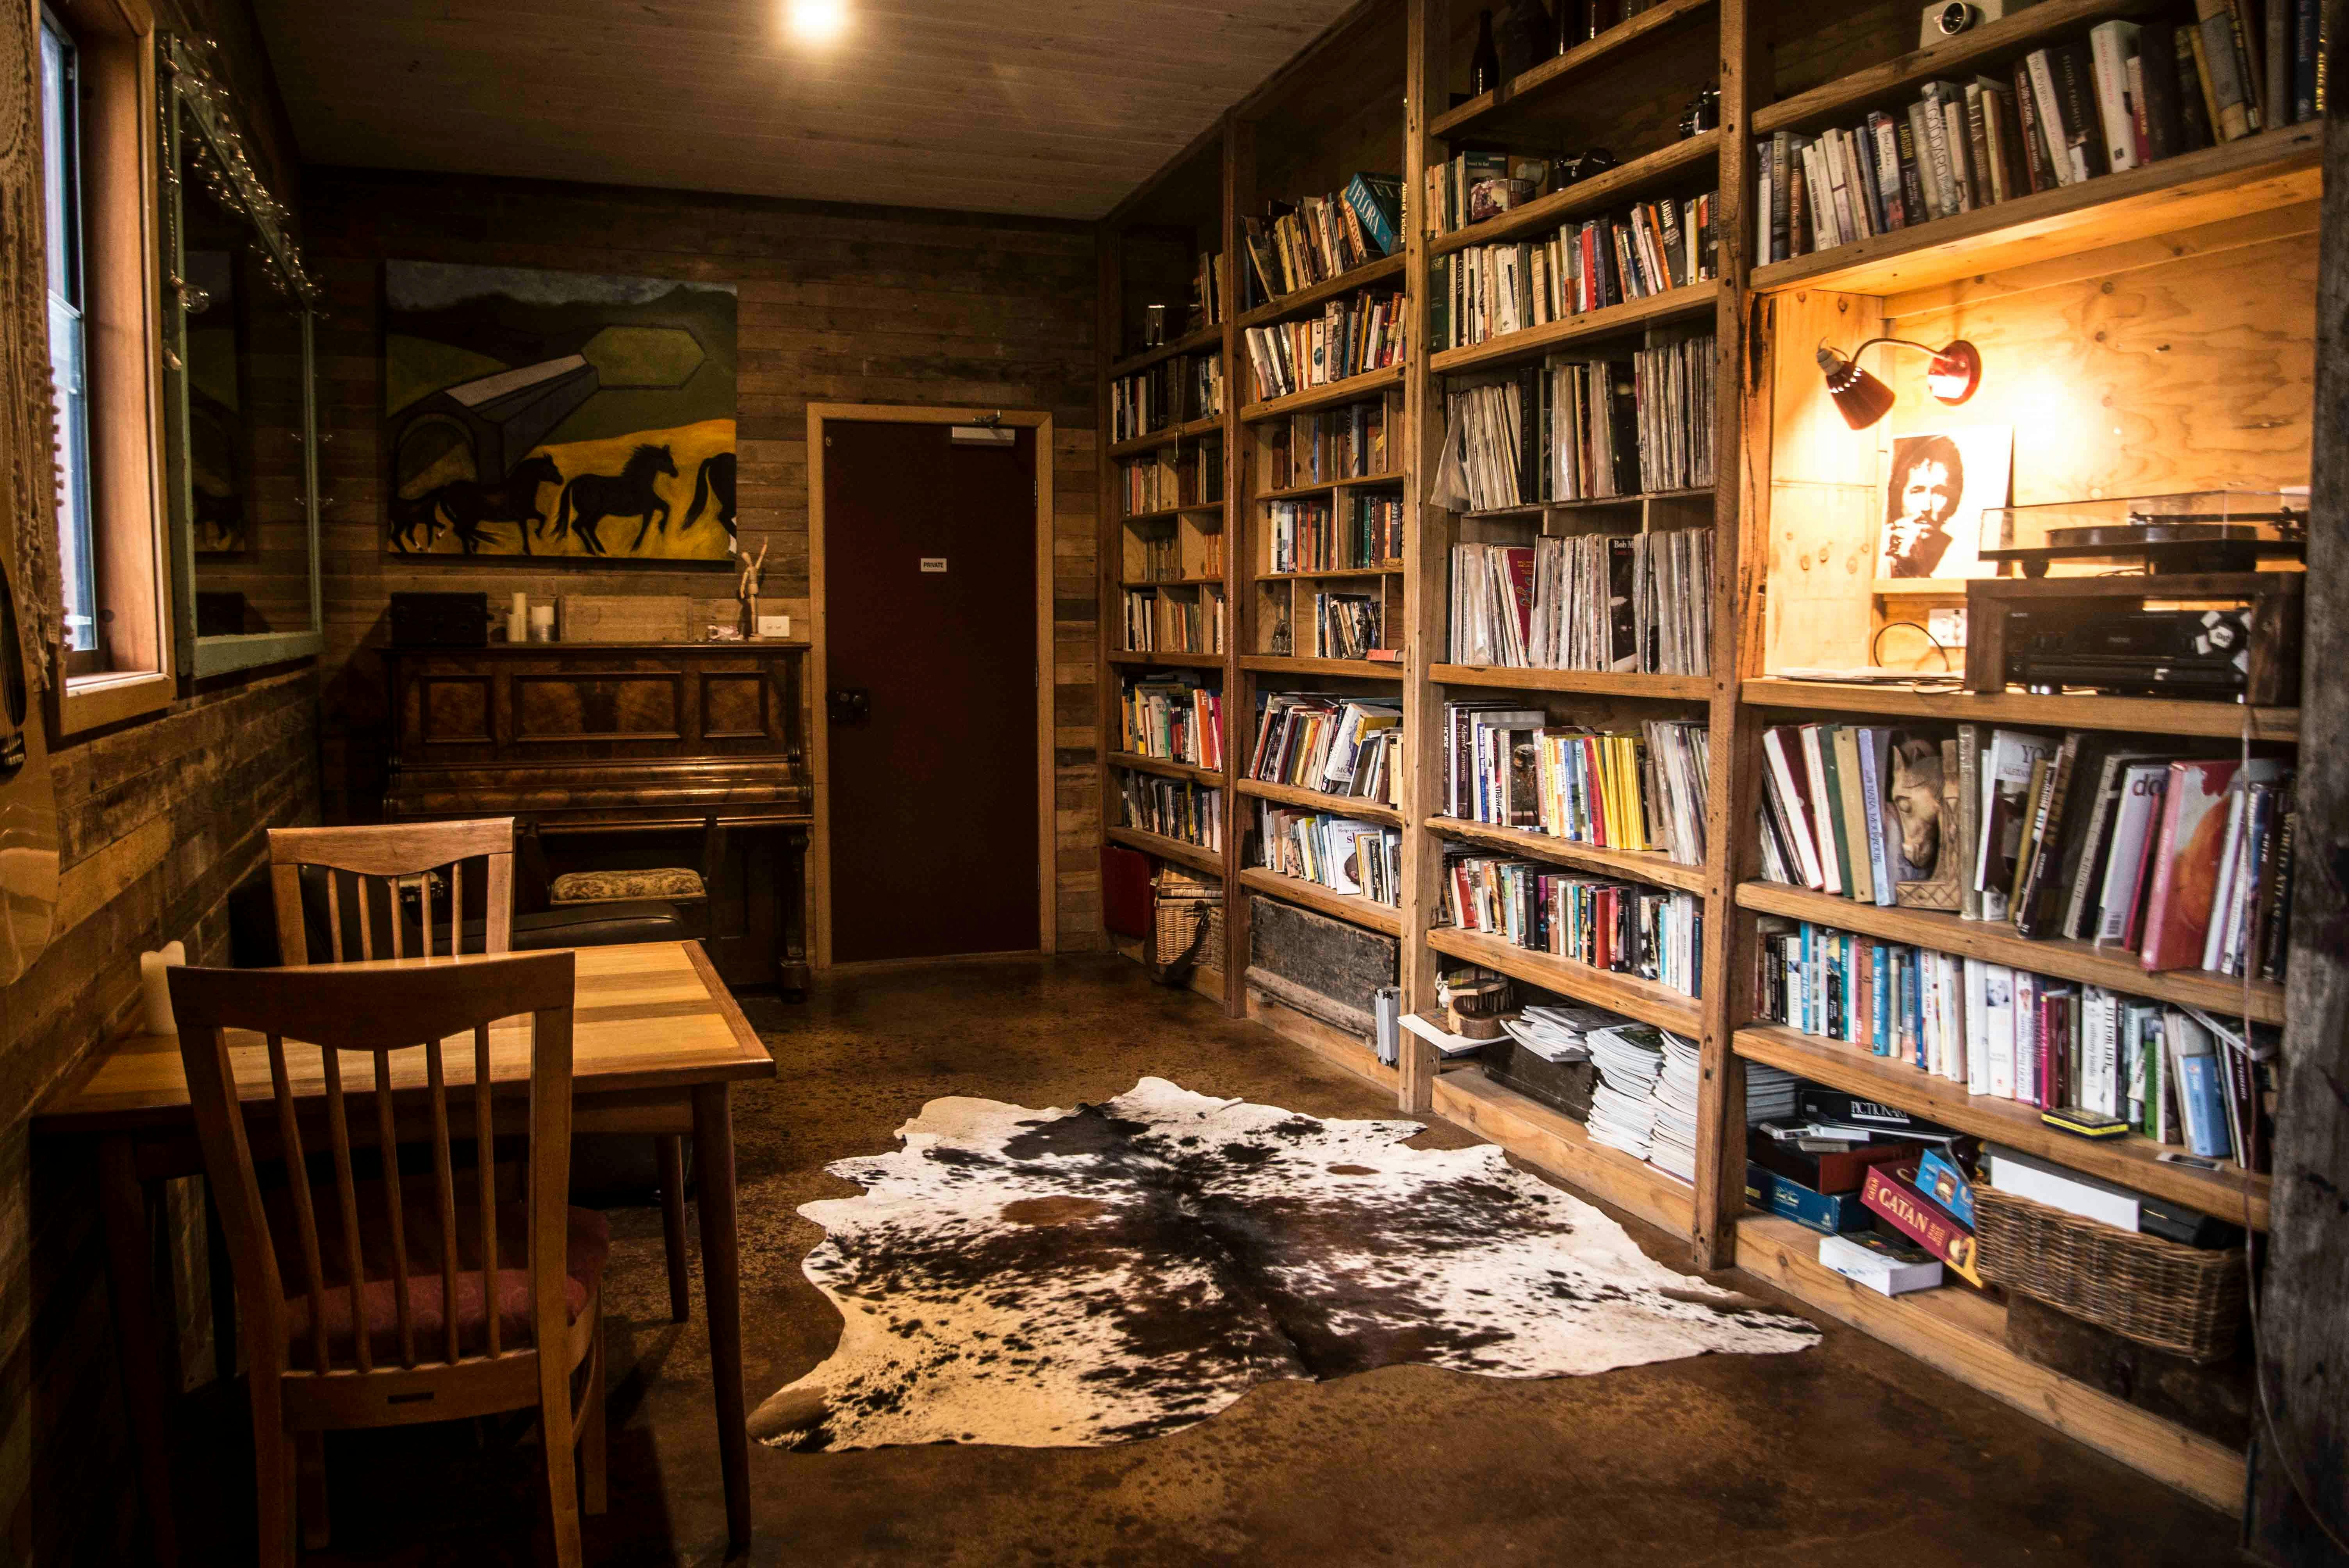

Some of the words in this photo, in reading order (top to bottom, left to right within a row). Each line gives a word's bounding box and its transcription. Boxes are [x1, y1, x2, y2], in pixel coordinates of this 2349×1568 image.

[1900, 123, 1913, 159] LARSSON
[1927, 108, 1947, 176] GODDARD
[1352, 185, 1379, 235] FLORA
[1661, 200, 1674, 228] LARSSON
[1346, 205, 1362, 253] PHYSICS
[1614, 540, 1627, 549] Bob
[2278, 812, 2295, 867] WORLD
[2273, 874, 2287, 917] ATLAS
[2105, 1007, 2114, 1021] FIT
[2087, 1022, 2098, 1053] anthony
[2105, 1025, 2114, 1044] FOR
[2105, 1047, 2114, 1069] LIFE
[2237, 1067, 2248, 1100] TASMANIA
[1868, 1177, 1880, 1200] CATAN
[1879, 1187, 1929, 1233] CATAN
